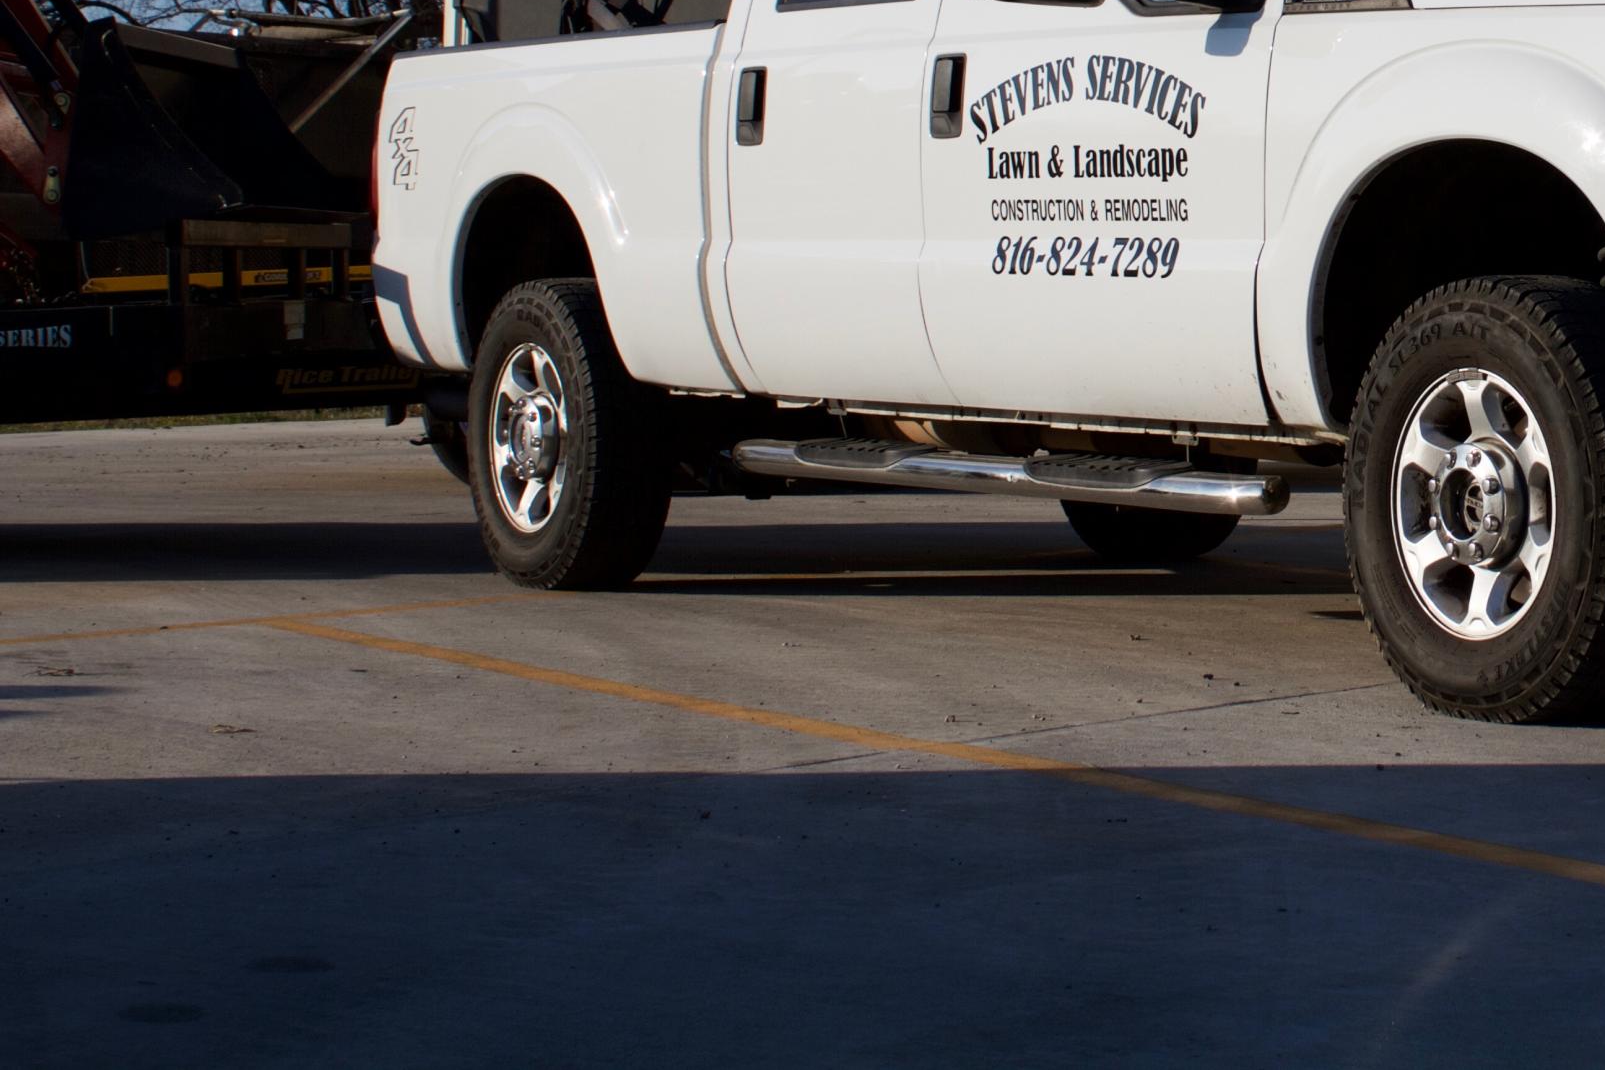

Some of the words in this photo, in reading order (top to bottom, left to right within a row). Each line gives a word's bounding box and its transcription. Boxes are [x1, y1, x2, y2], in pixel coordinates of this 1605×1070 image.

[970, 56, 1075, 144] STEVENS
[1086, 54, 1206, 138] SERVICES
[987, 146, 1040, 179] Lawn
[1047, 144, 1064, 178] &
[1073, 143, 1189, 182] Landscape
[991, 198, 1085, 221] CONSTRUCTION
[1090, 199, 1099, 220] &
[1105, 198, 1189, 221] REMODELING
[991, 235, 1181, 279] 816-824-7289
